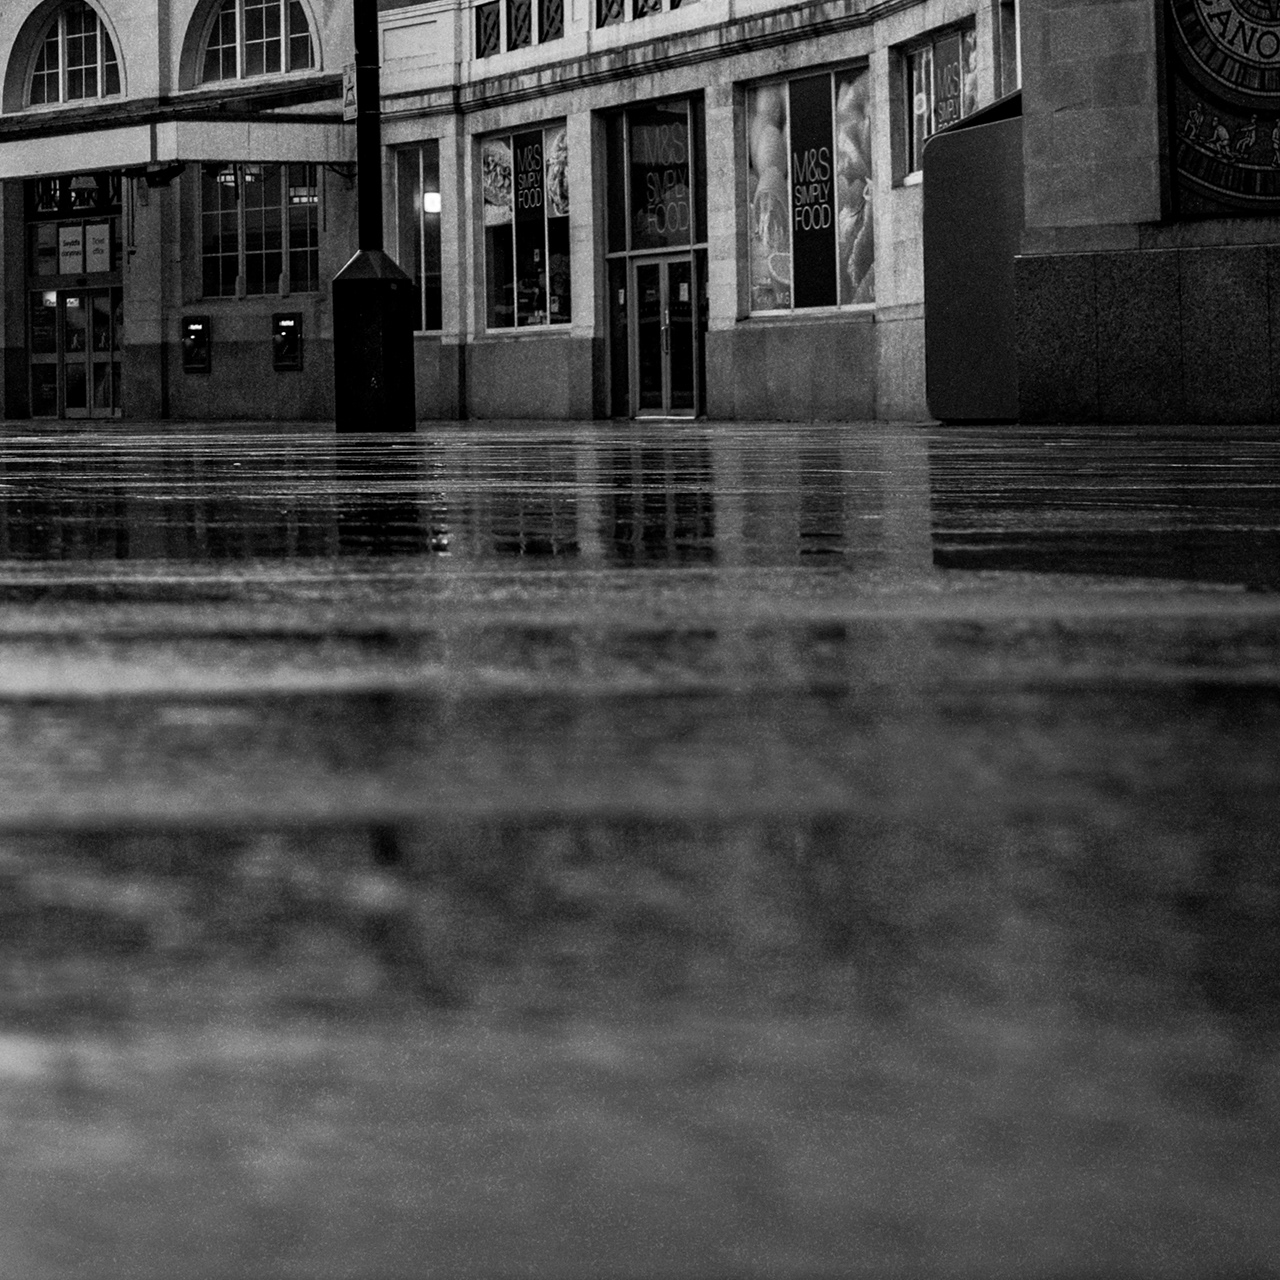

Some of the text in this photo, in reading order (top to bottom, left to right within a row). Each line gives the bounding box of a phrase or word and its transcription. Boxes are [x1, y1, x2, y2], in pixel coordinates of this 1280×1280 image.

[517, 144, 541, 172] M&S
[643, 122, 686, 166] M&S
[793, 147, 830, 183] M&S
[518, 188, 542, 209] FOOD
[794, 182, 830, 206] SIMPLY
[647, 202, 689, 234] FOOD
[794, 204, 831, 231] FOOD
